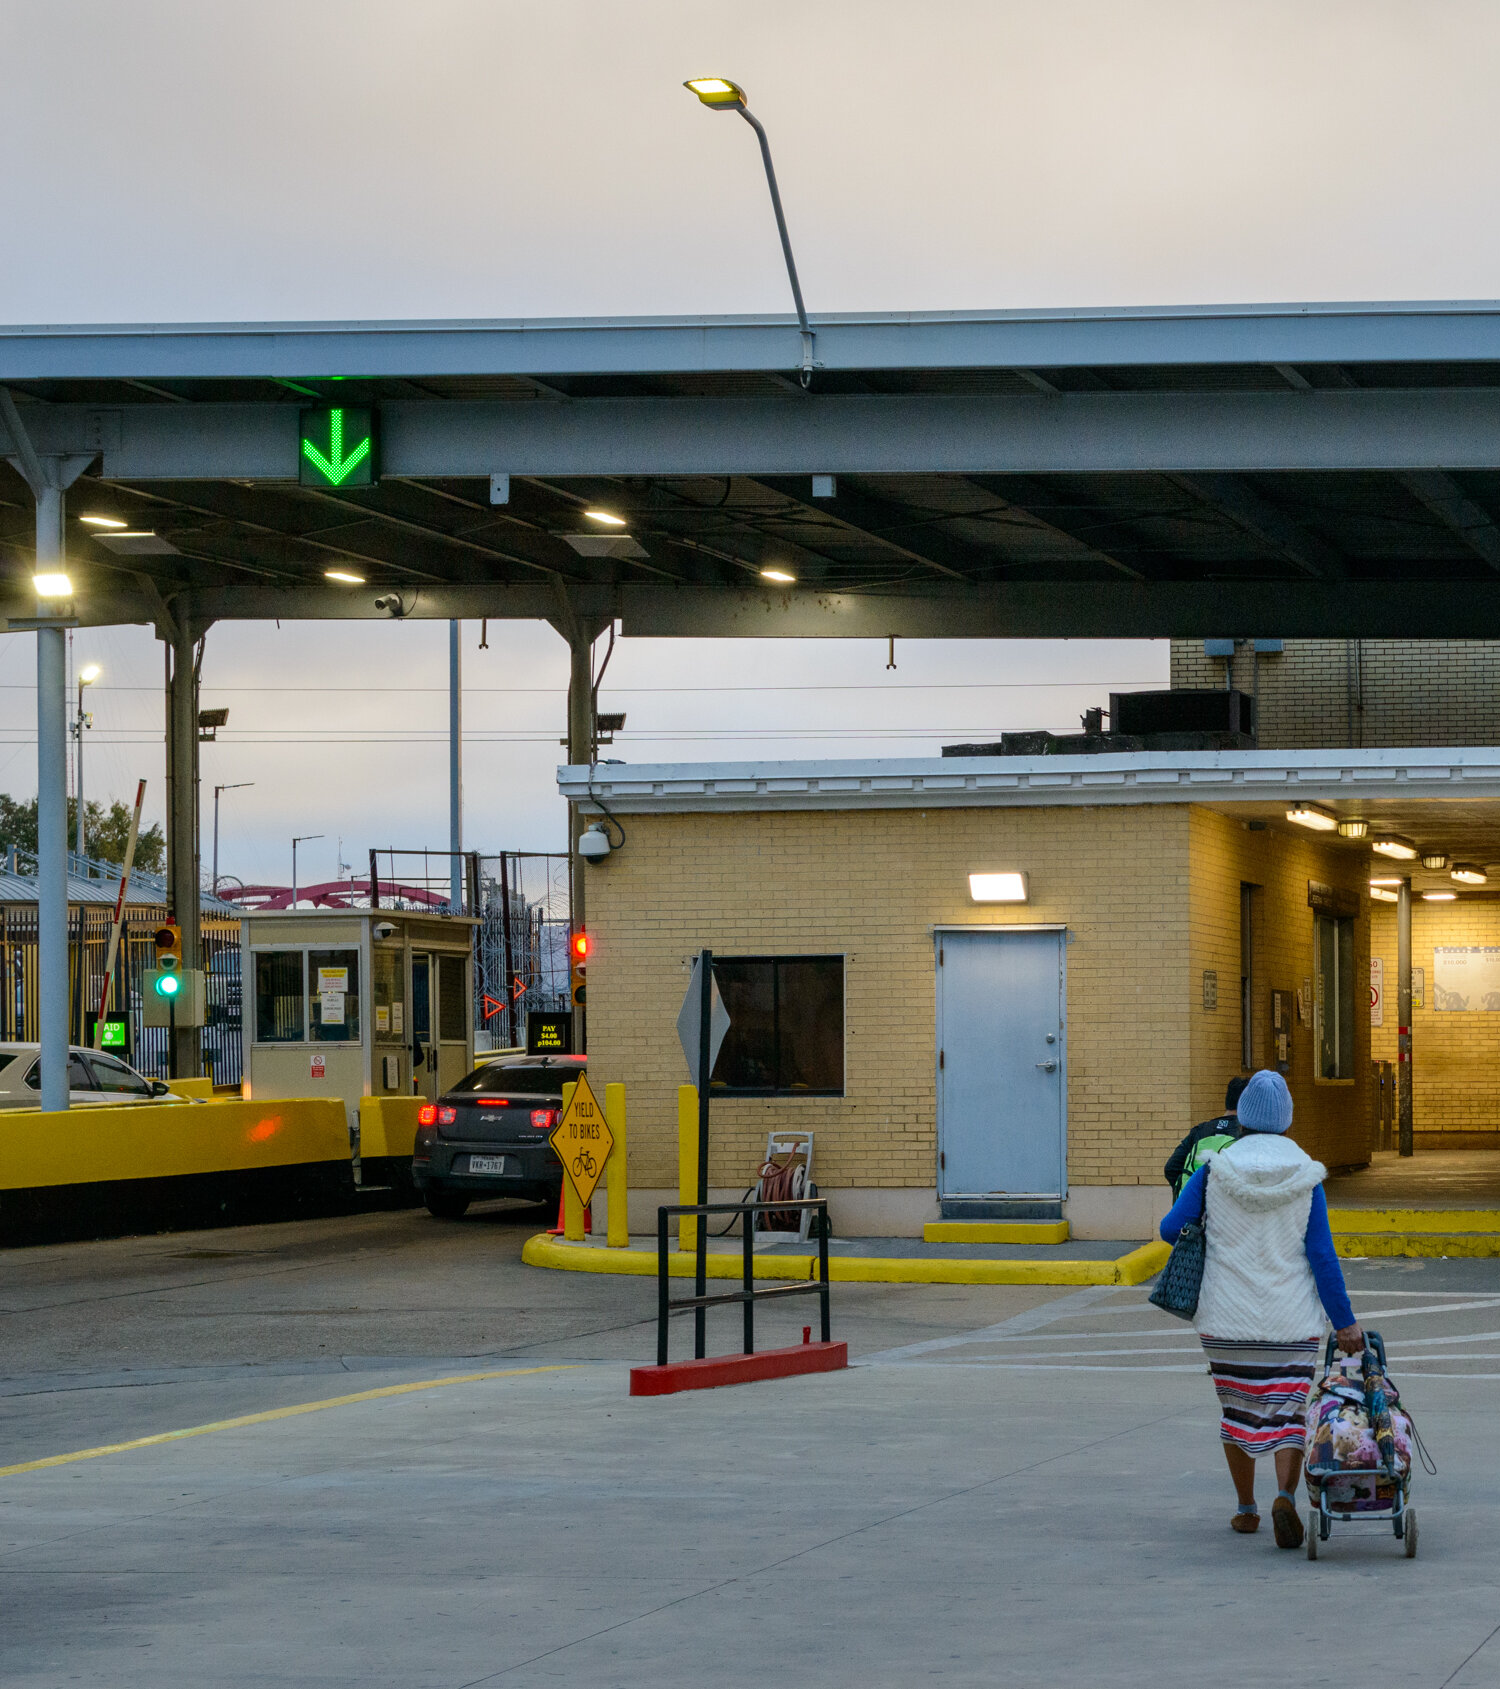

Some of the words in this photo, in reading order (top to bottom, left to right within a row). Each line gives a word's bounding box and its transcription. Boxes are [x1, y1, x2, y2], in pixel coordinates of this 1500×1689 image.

[103, 1023, 120, 1031] AID
[574, 1102, 594, 1118] YIELD
[569, 1124, 578, 1139] TO
[580, 1124, 600, 1139] BIKES
